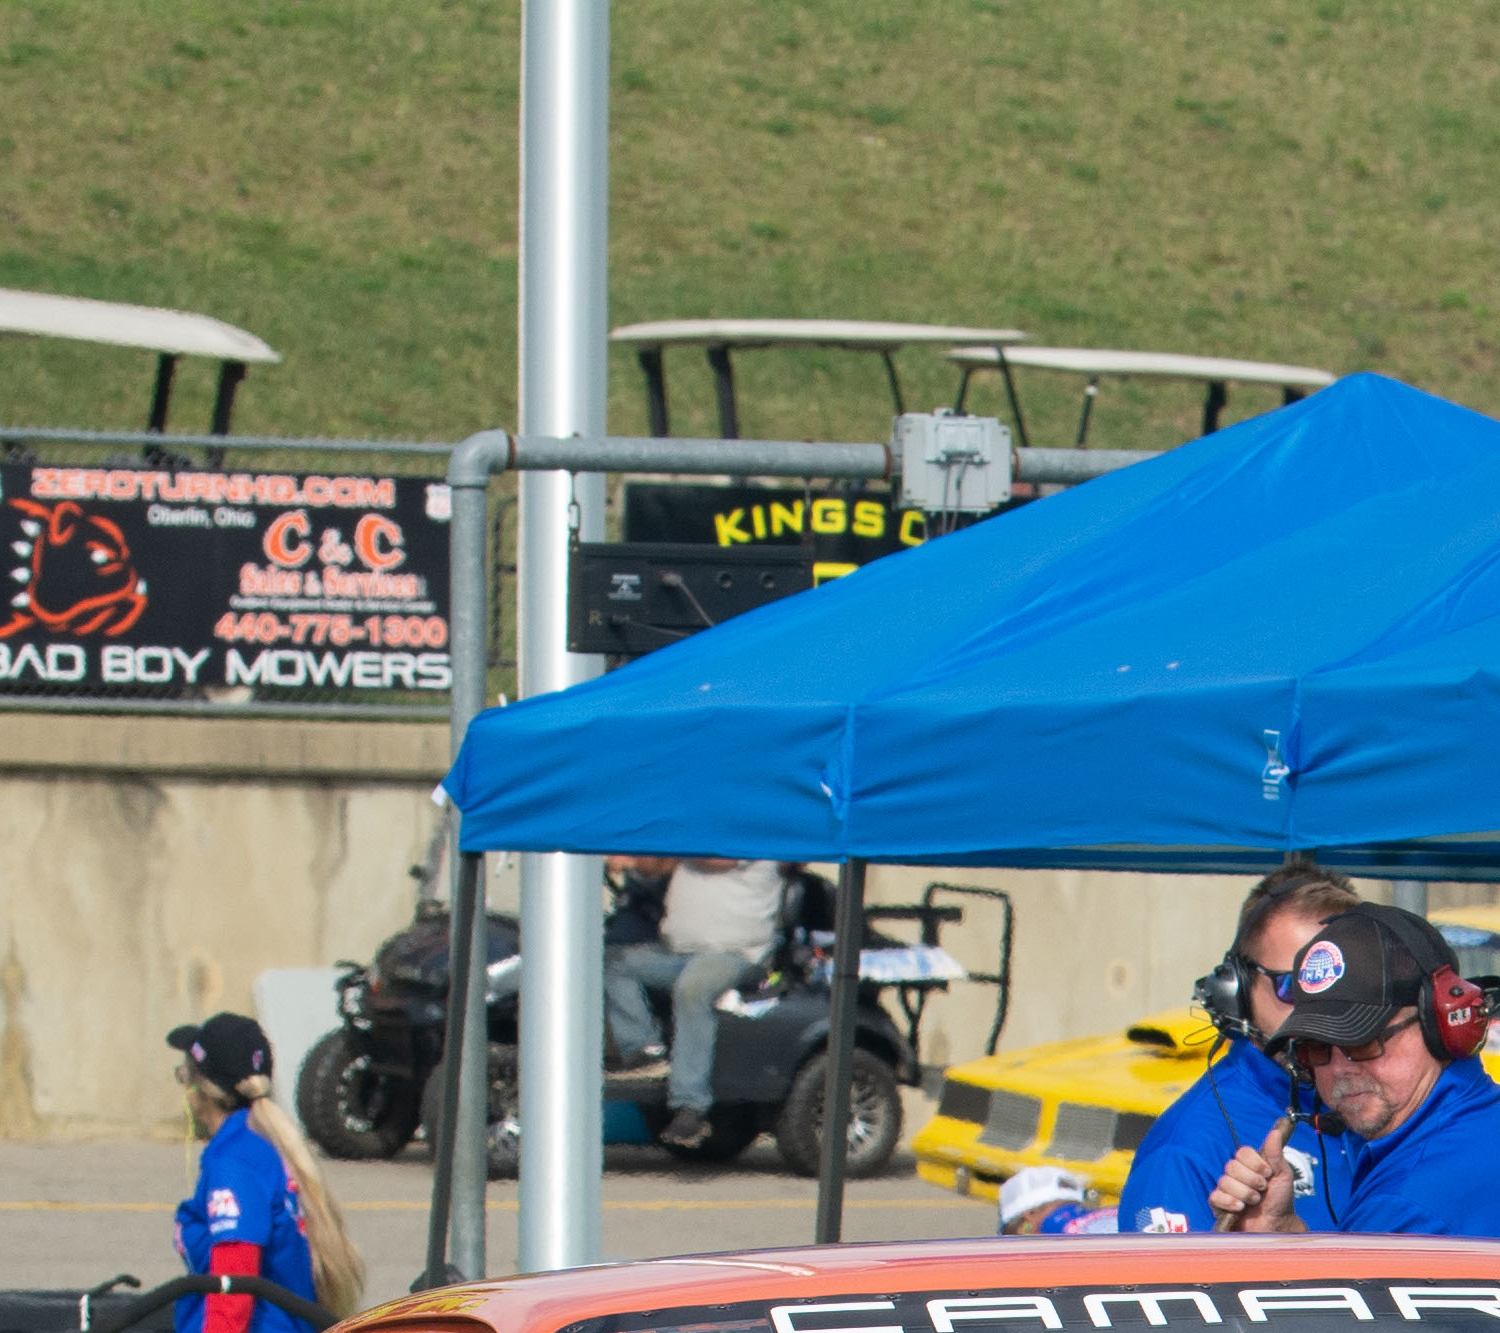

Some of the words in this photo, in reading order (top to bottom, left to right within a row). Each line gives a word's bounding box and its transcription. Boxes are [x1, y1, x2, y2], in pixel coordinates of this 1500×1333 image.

[263, 508, 313, 568] C
[318, 526, 353, 566] &
[354, 512, 406, 571] C
[714, 498, 885, 548] KINGS
[239, 562, 301, 596] Sales
[213, 611, 449, 649] 440-775-1300
[100, 646, 209, 684] BOY
[226, 648, 453, 689] MOWERS
